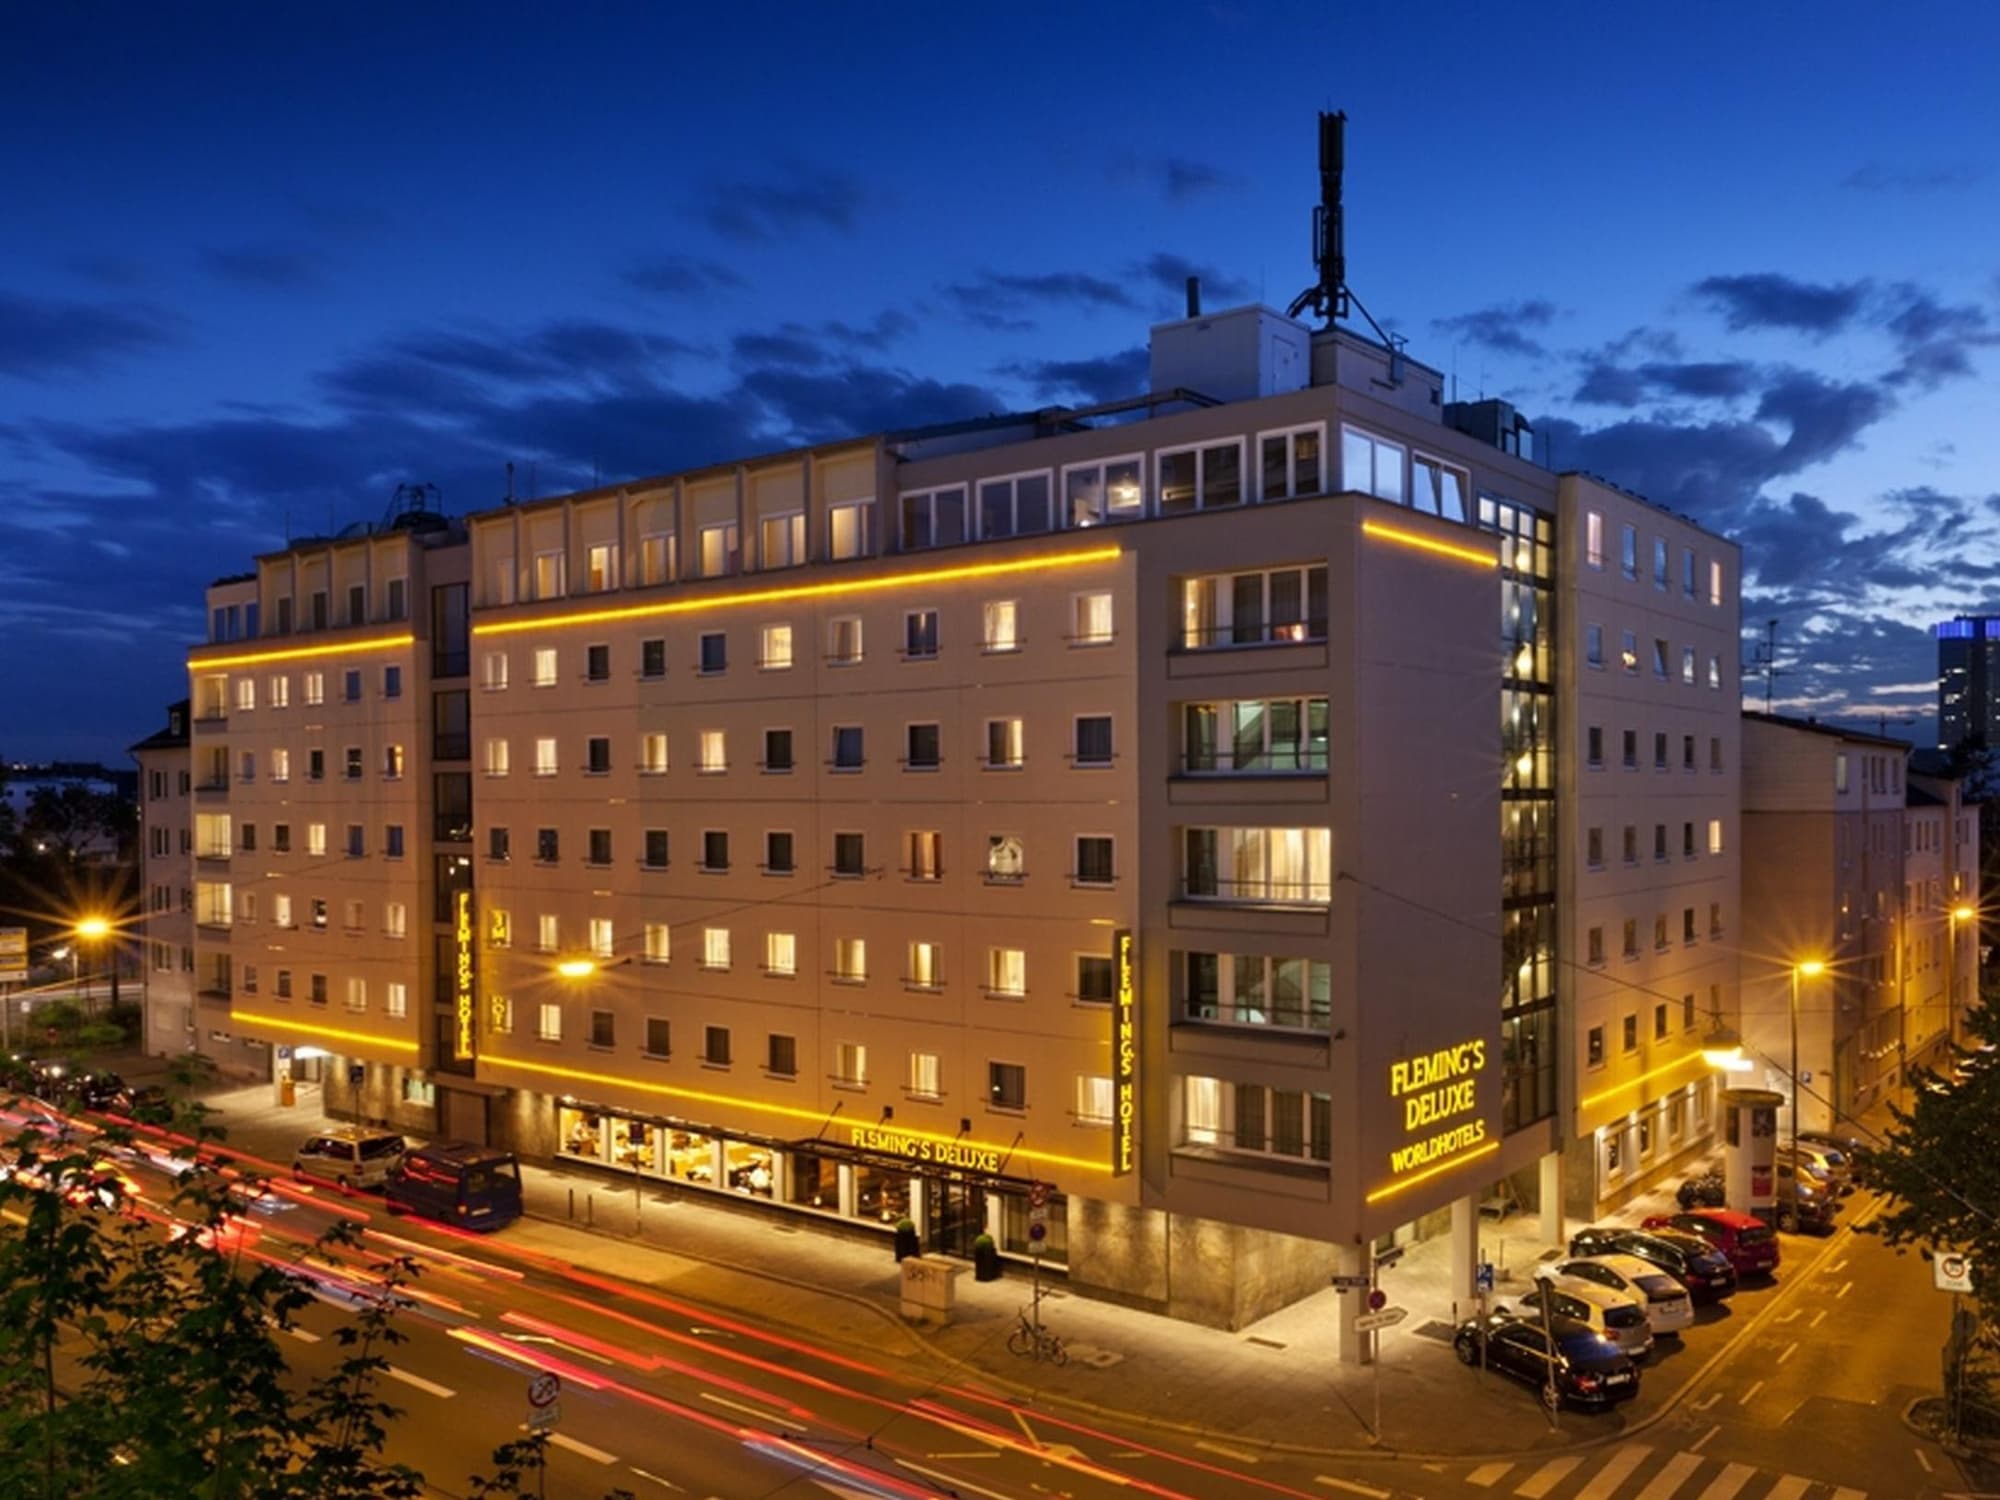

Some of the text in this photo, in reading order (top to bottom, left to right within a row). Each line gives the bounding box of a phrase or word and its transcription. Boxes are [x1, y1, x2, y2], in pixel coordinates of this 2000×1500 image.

[1391, 1040, 1485, 1096] FLEMING'S
[1120, 1084, 1133, 1171] HOTEL
[1405, 1079, 1475, 1130] DELUXE
[851, 1128, 998, 1172] FLEMING'S DELUXE
[1391, 1119, 1485, 1173] WORLDHOTELS
